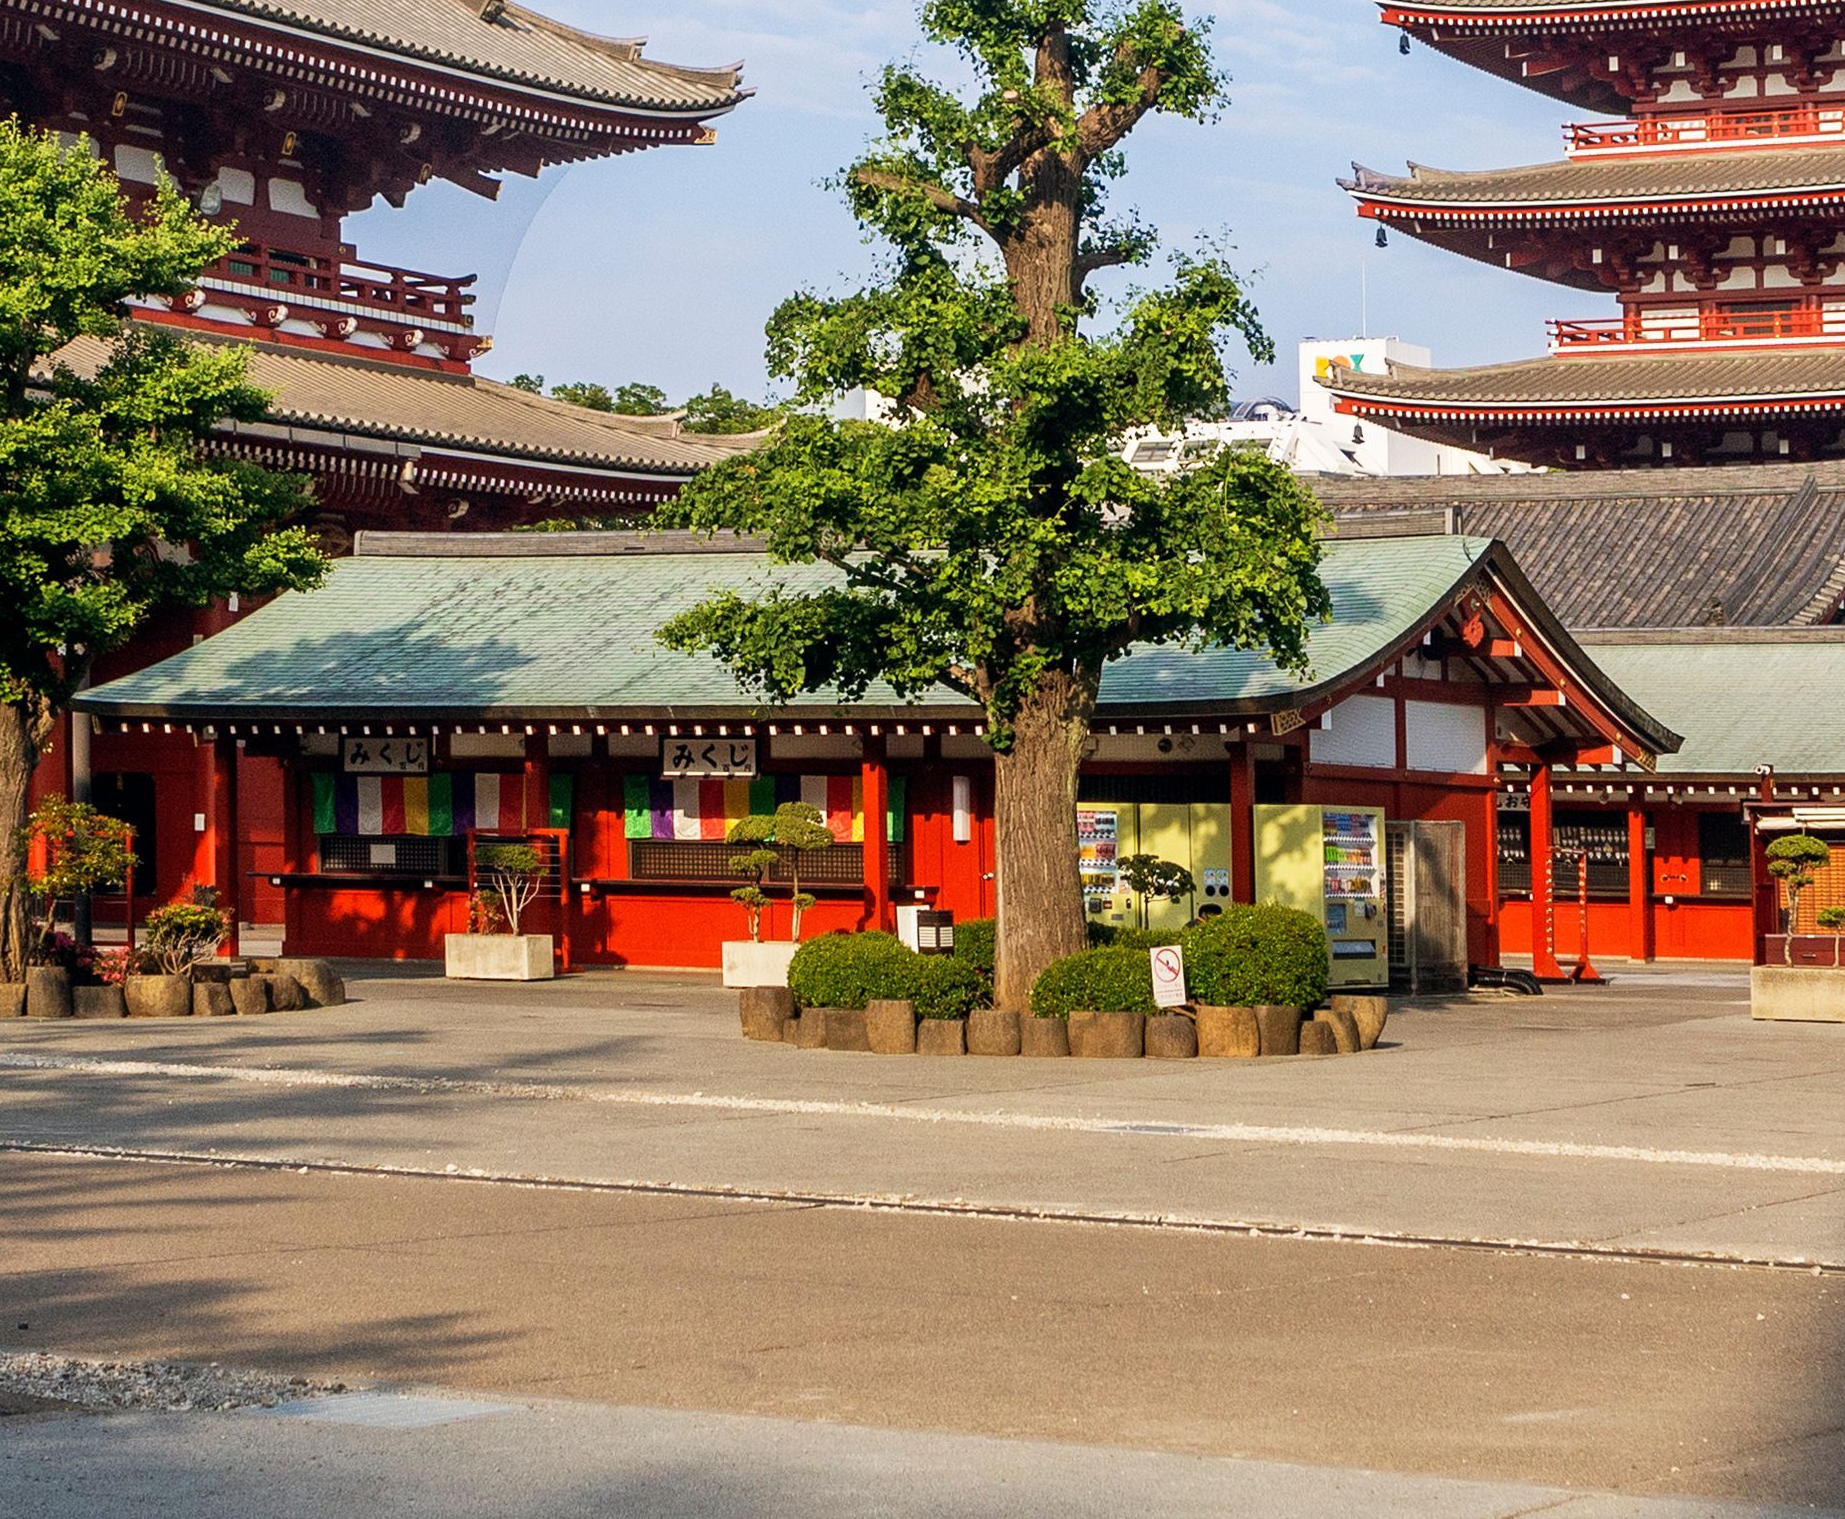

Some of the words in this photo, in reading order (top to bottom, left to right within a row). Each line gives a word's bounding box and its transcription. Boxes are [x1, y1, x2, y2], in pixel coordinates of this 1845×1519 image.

[351, 743, 423, 764] みくじ
[673, 744, 748, 769] みくじ
